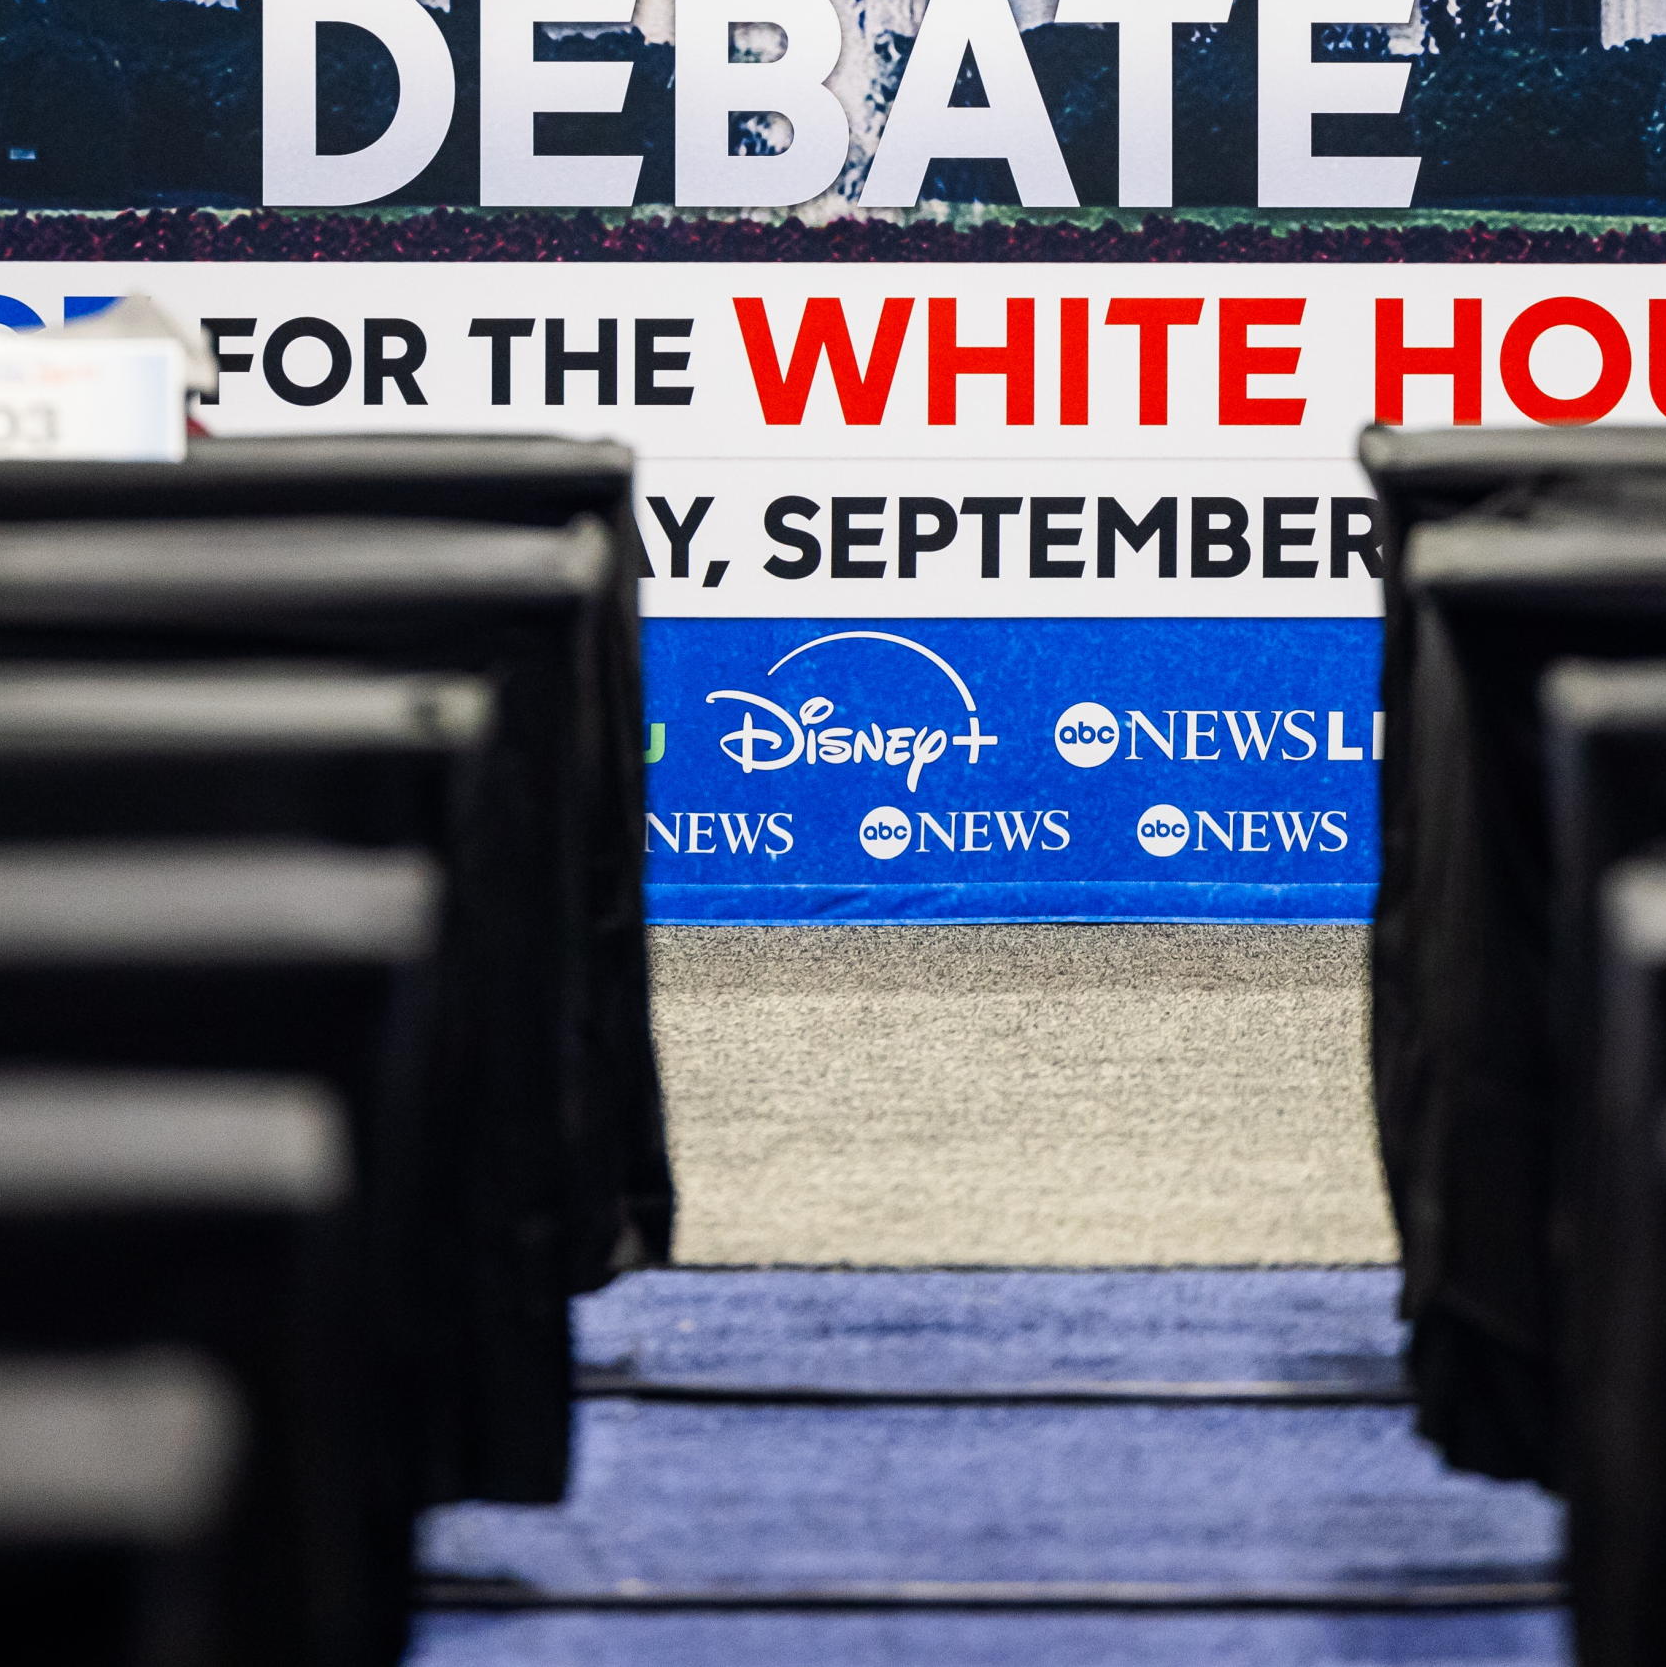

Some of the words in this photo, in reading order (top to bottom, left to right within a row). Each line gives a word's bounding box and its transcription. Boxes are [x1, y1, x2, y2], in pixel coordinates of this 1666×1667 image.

[200, 316, 429, 407] FOR
[468, 317, 694, 406] THE
[732, 297, 1308, 425] WHITE
[763, 495, 1385, 580] SEPTEMBER
[643, 812, 794, 854] NEWS
[915, 810, 1071, 853] NEWS
[1193, 810, 1349, 852] NEWS
